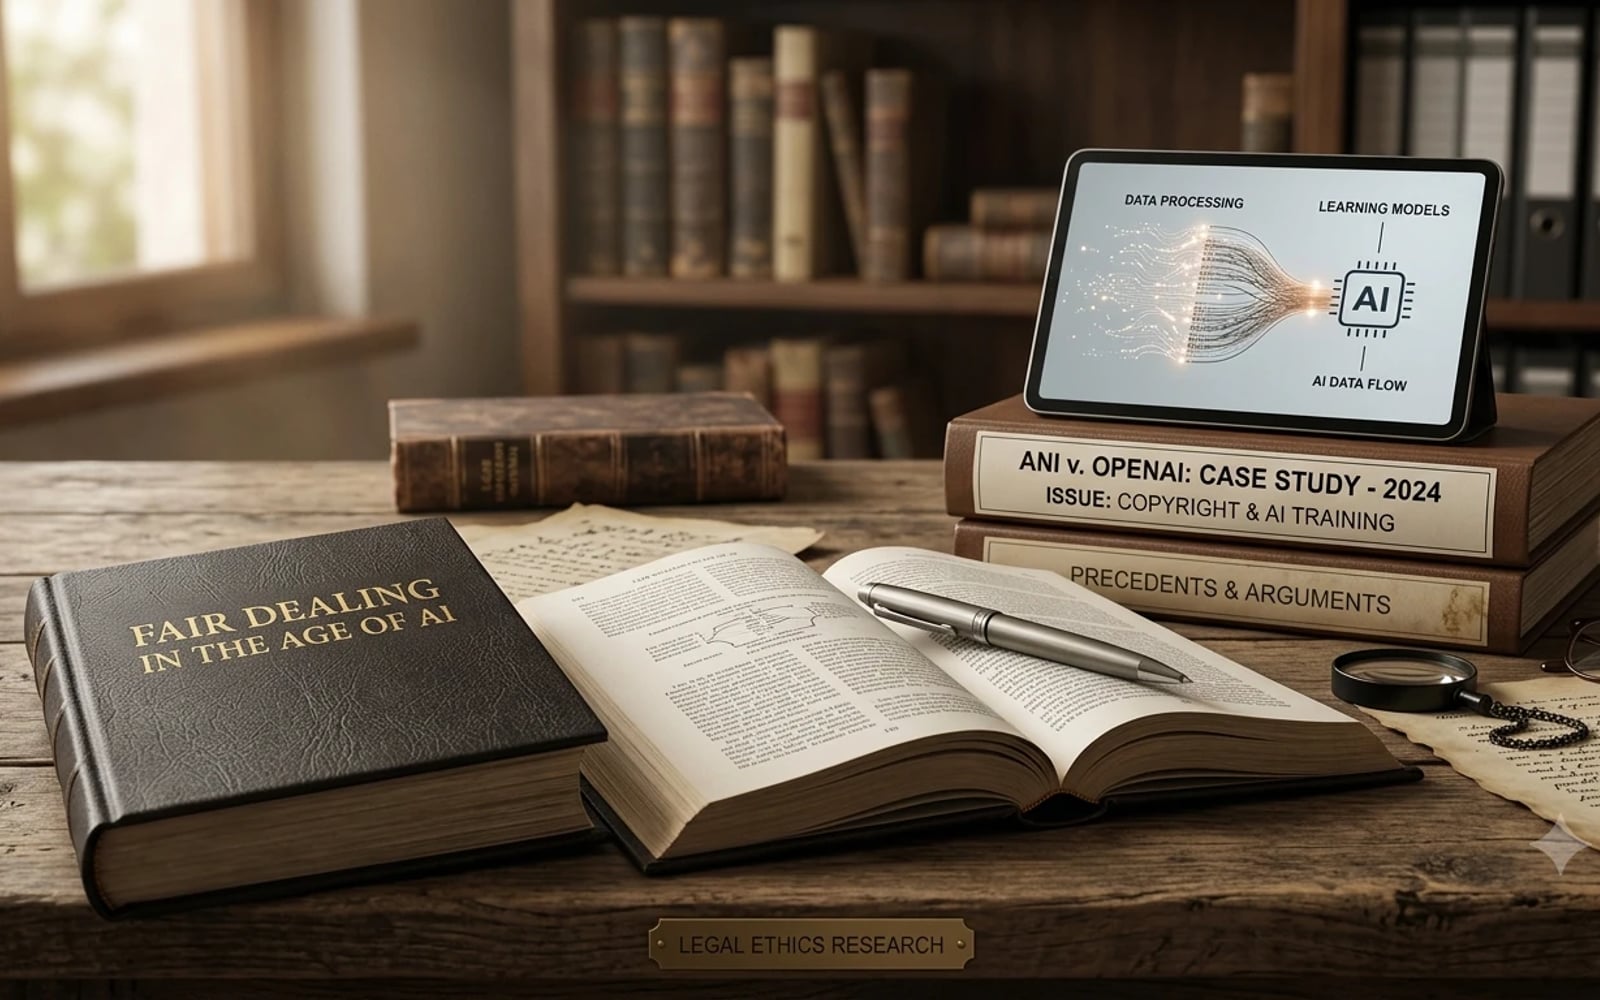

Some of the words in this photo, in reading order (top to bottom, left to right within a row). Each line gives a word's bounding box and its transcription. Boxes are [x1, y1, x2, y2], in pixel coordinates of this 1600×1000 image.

[1124, 194, 1157, 207] DATA
[1160, 195, 1244, 209] PROCESSING
[1319, 201, 1388, 215] LEARNING
[1391, 203, 1450, 217] MODELS
[1352, 285, 1389, 313] AI
[1312, 375, 1327, 388] AI
[1329, 376, 1364, 390] DATA
[1366, 378, 1407, 392] FLOW
[1019, 450, 1060, 473] ANI
[1067, 457, 1085, 476] v.
[1092, 456, 1191, 483] OPENAI:
[1199, 464, 1267, 489] CASE
[1274, 470, 1361, 496] STUDY
[1383, 478, 1442, 503] 2024
[1046, 485, 1111, 508] ISSUE:
[1117, 492, 1240, 520] COPYRIGHT
[1246, 503, 1259, 521] &
[1265, 504, 1285, 523] AI
[1291, 506, 1396, 532] TRAINING
[1071, 566, 1217, 597] PRECEDENTS
[1225, 581, 1239, 599] &
[1245, 582, 1391, 614] ARGUMENTS
[130, 612, 237, 647] FAIR
[242, 578, 440, 629] DEALING
[139, 650, 182, 674] IN
[191, 635, 270, 664] THE
[280, 622, 352, 650] AGE
[360, 612, 405, 635] OF
[420, 605, 457, 628] AI
[679, 936, 744, 954] LEGAL
[751, 936, 825, 955] ETHICS
[832, 936, 944, 955] RESEARCH
